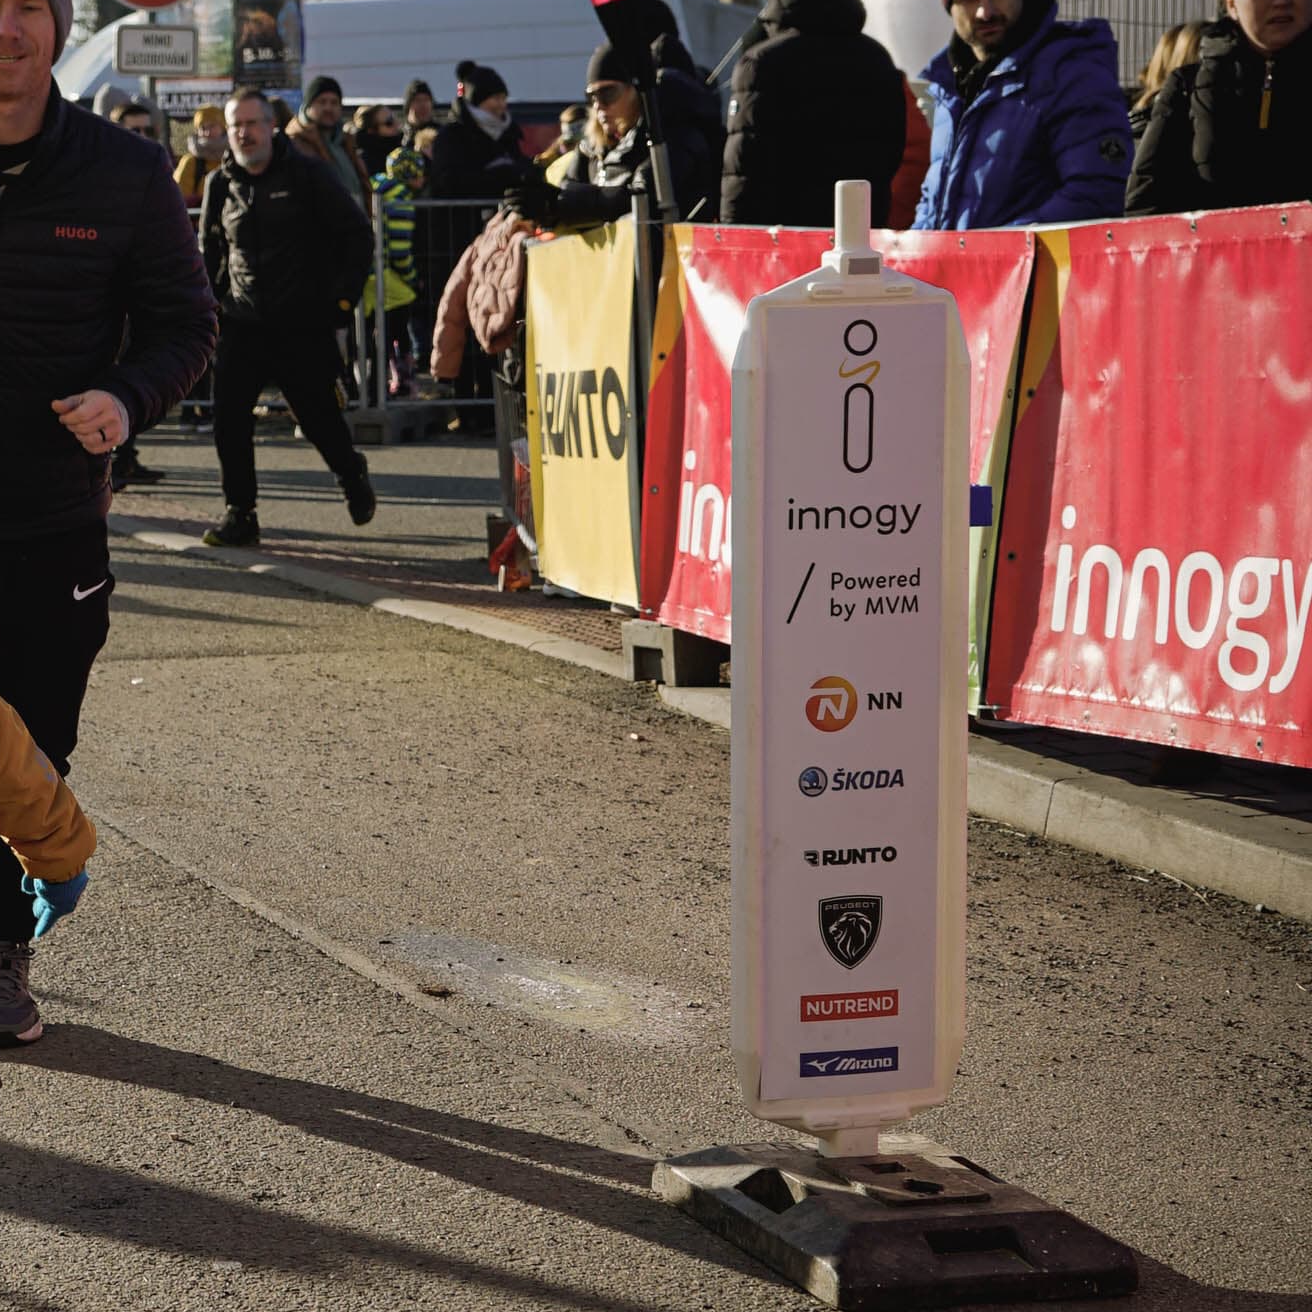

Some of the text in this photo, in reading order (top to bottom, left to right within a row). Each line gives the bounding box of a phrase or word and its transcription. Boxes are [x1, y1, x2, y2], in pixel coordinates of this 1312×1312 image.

[55, 225, 98, 240] HUGO
[788, 498, 922, 535] innogy
[831, 568, 921, 591] Powered
[830, 595, 919, 622] by MVM
[1051, 504, 1312, 694] innogy
[868, 692, 902, 710] NN
[831, 768, 905, 792] ŠKODA
[822, 846, 897, 866] RUNTO
[824, 901, 877, 911] PEUGEOT
[806, 995, 894, 1016] NUTREND
